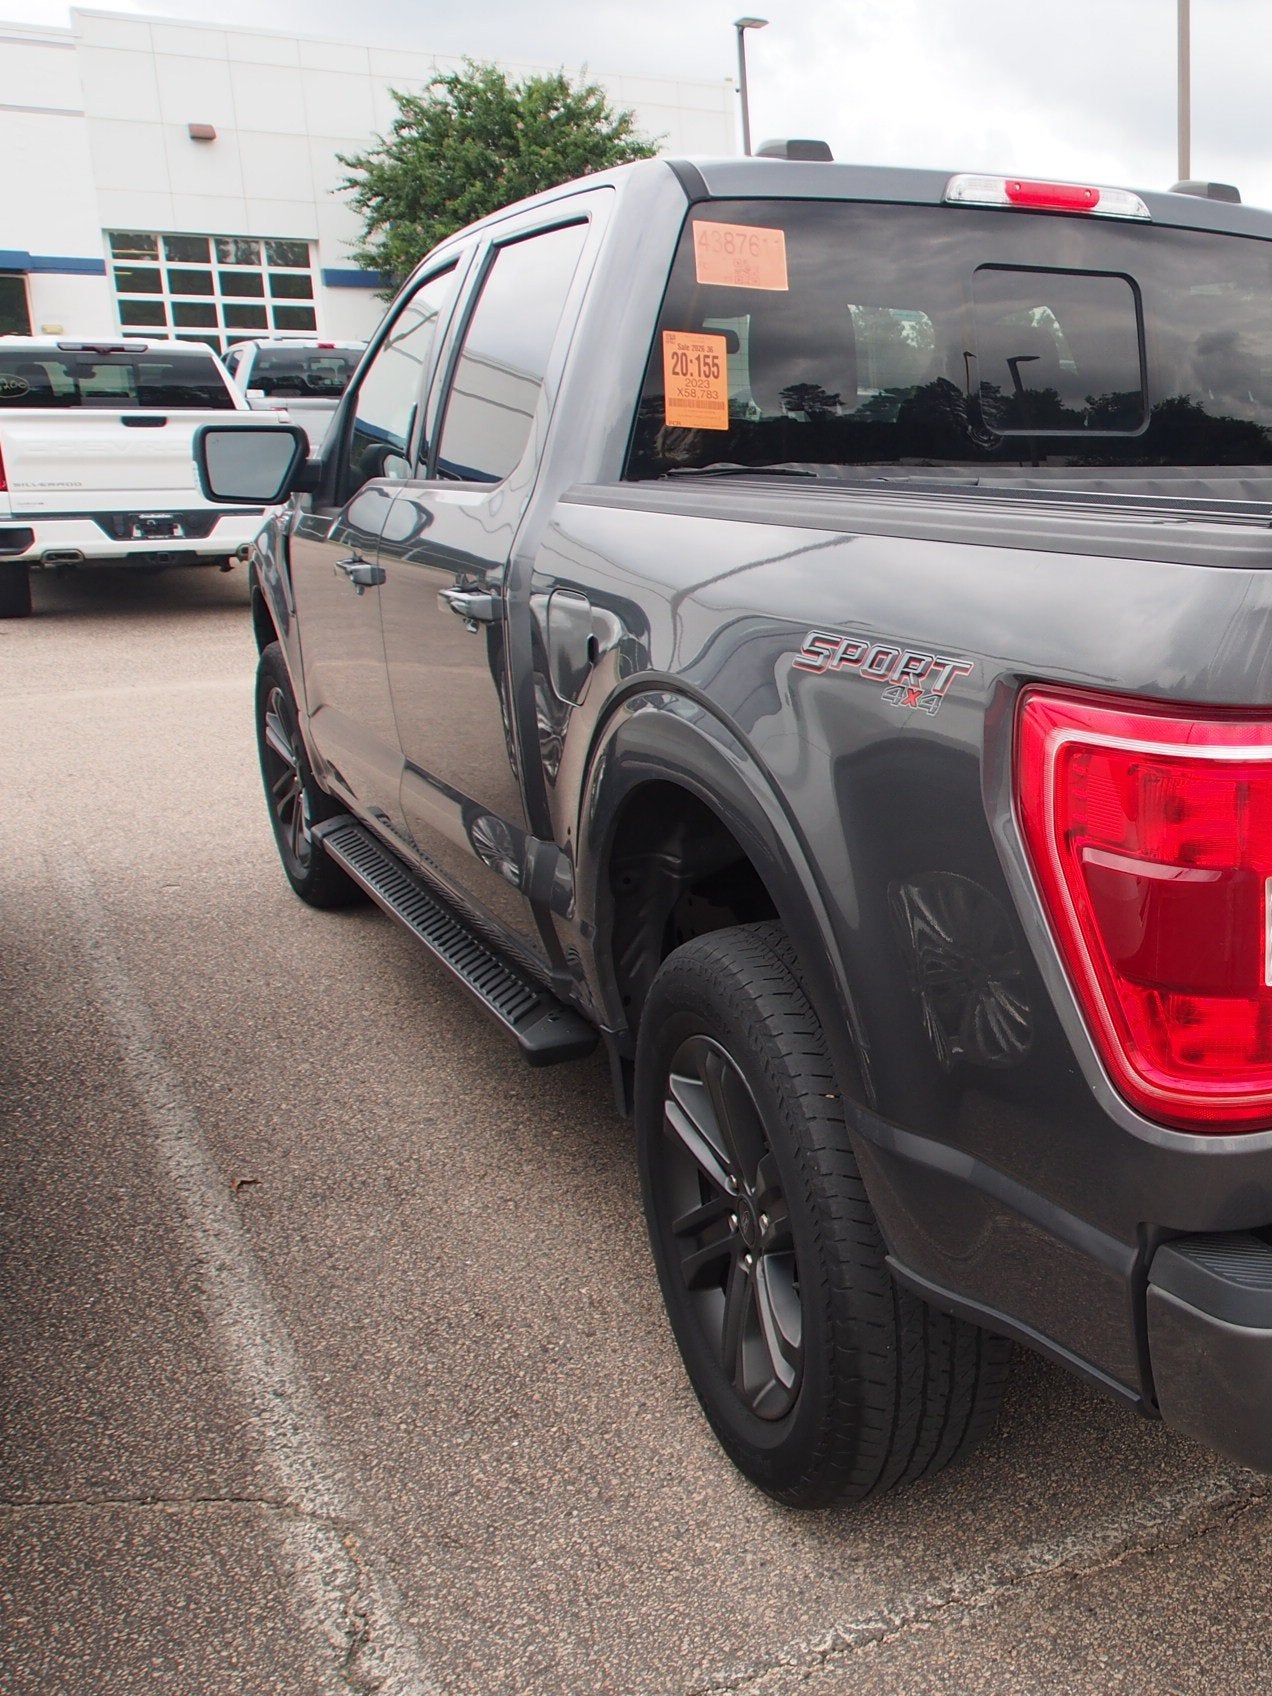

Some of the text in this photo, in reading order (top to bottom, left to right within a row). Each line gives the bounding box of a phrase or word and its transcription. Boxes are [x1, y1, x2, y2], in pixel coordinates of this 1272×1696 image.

[677, 343, 690, 352] Sale
[671, 351, 720, 380] 20:155
[685, 377, 711, 389] 2023
[792, 629, 974, 695] SPORT
